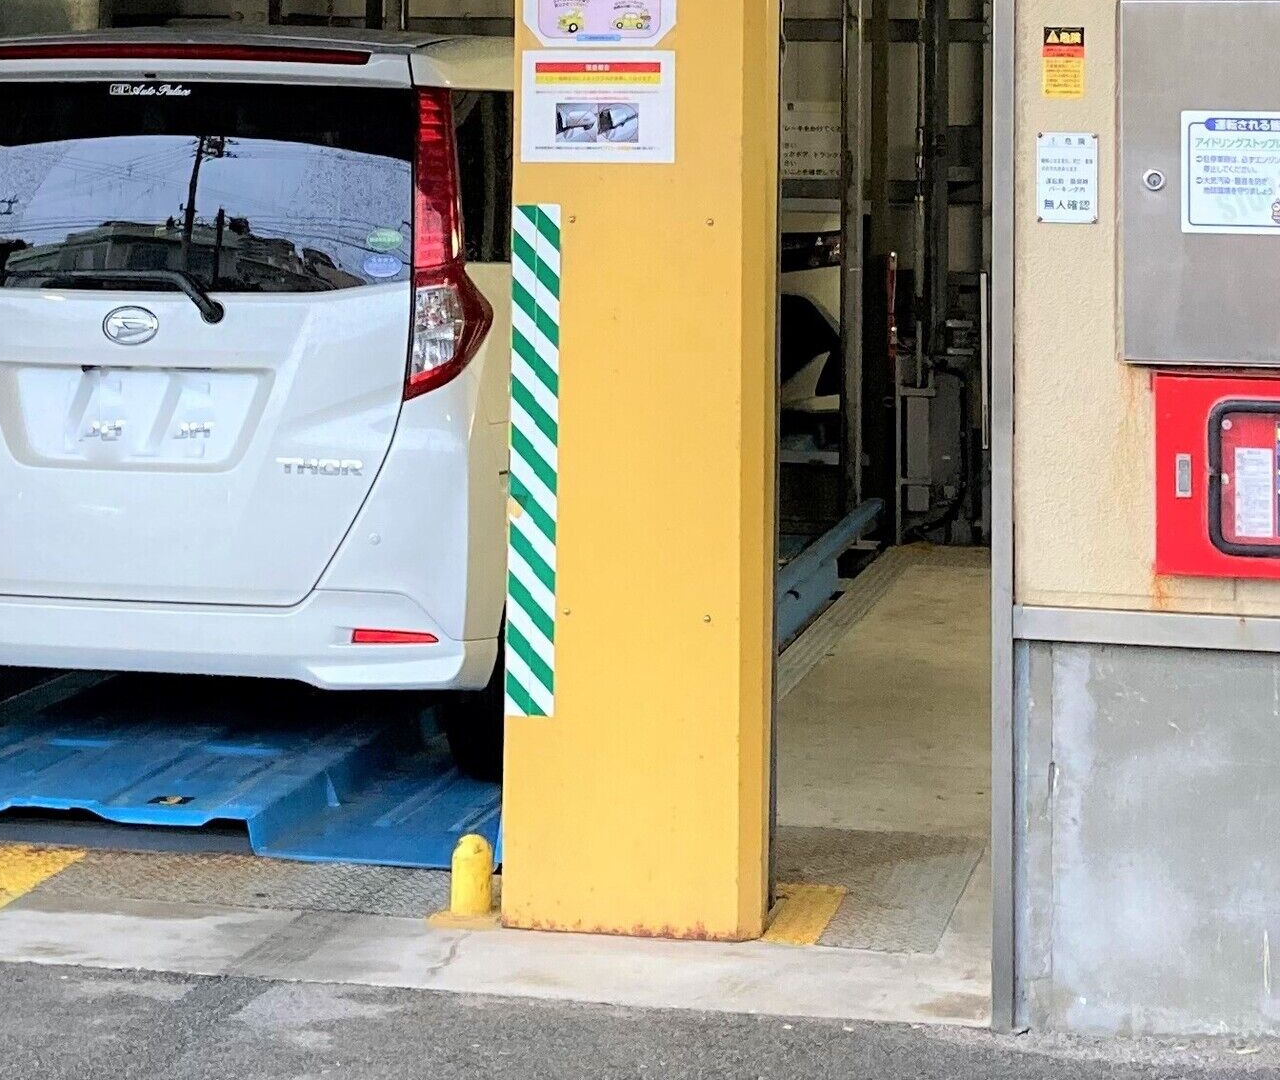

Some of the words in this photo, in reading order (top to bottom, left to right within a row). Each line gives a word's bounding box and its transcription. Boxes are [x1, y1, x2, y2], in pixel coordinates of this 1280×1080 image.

[1043, 199, 1091, 211] 無人確認
[275, 457, 363, 476] THOR
